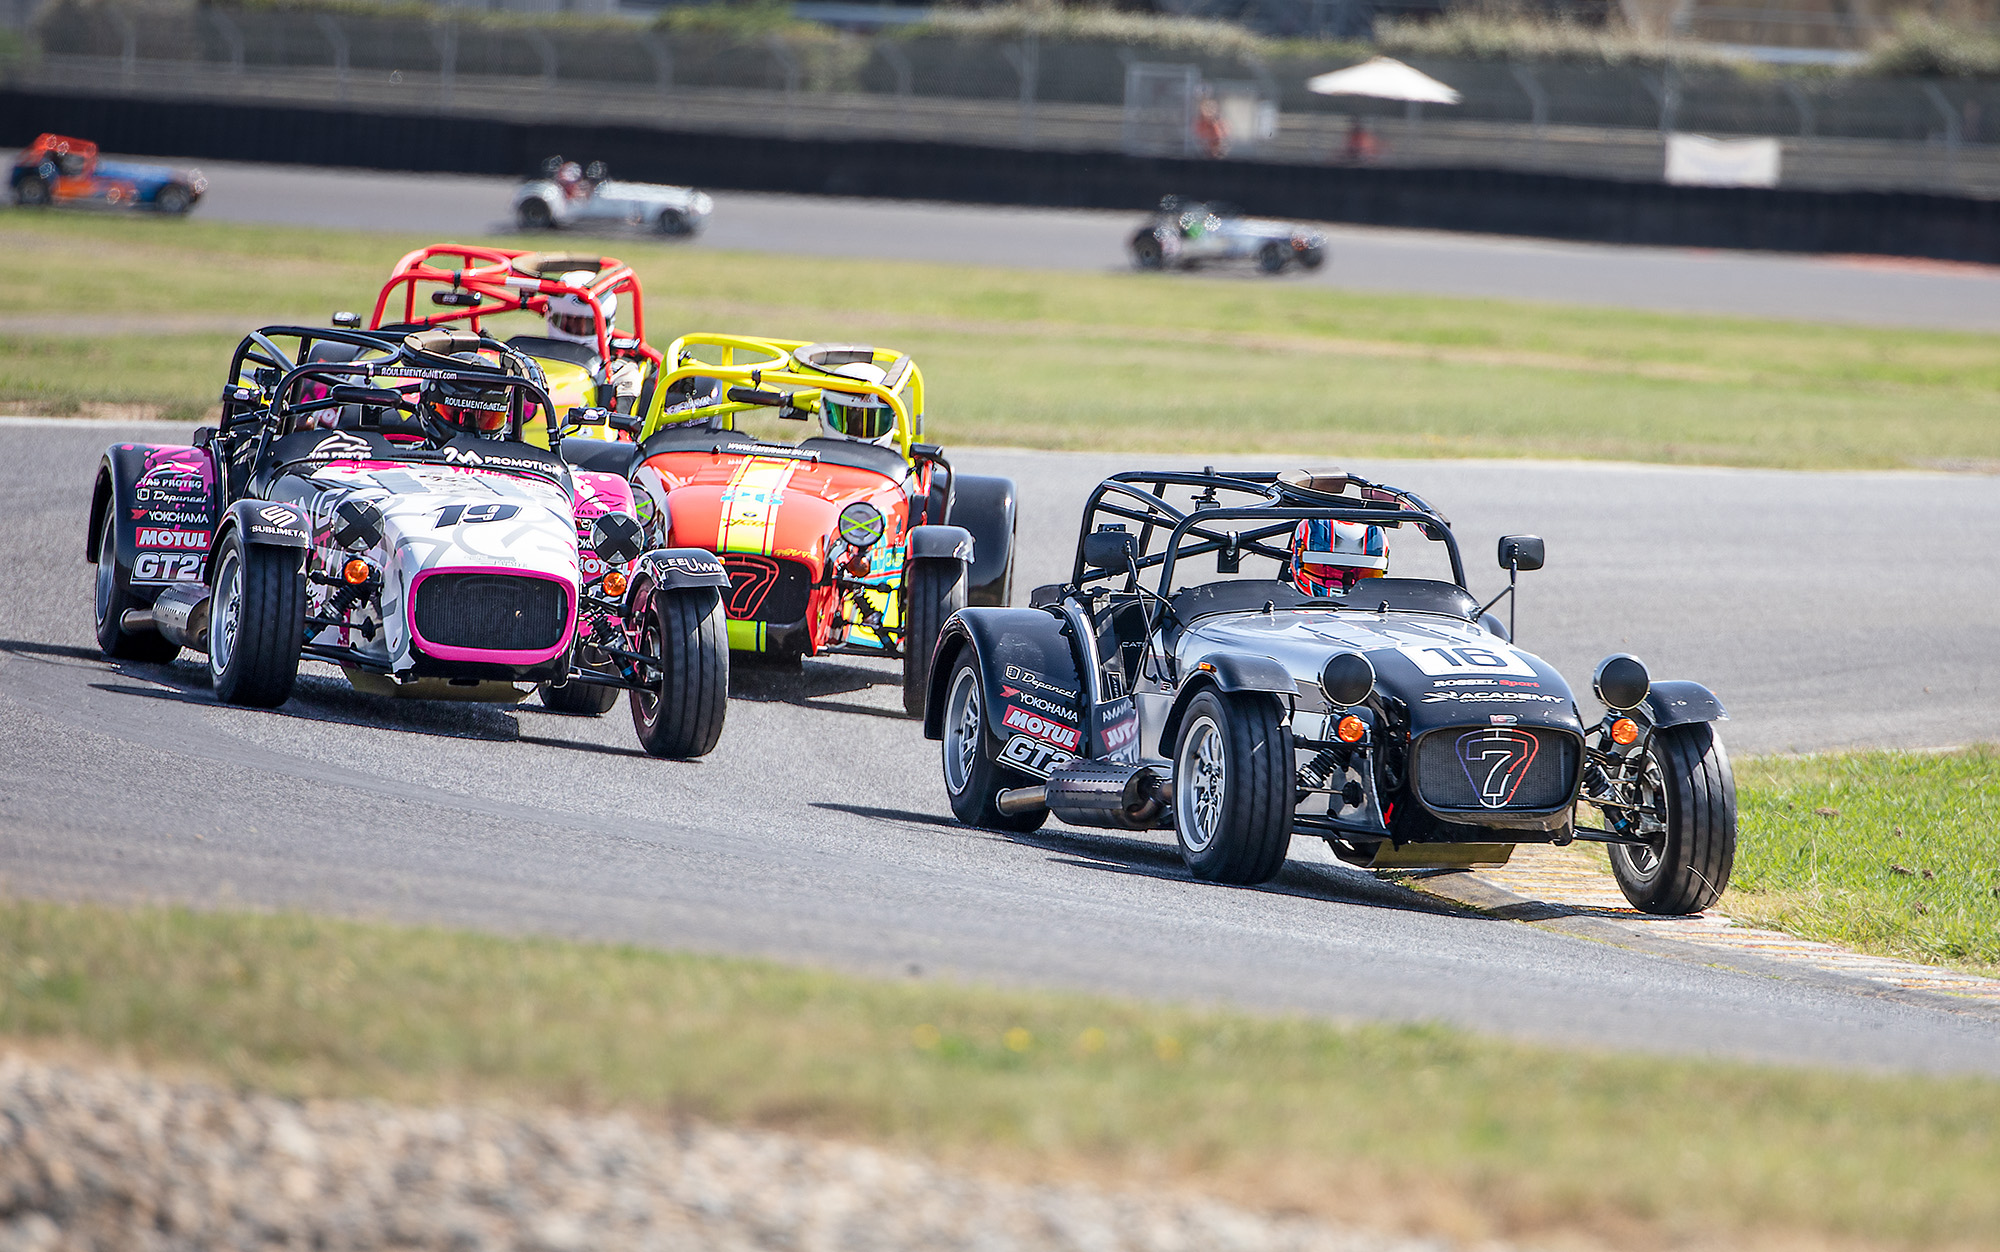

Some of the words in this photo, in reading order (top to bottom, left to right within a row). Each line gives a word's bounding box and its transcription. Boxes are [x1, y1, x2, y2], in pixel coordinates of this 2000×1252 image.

[484, 456, 561, 476] PROMOTION
[148, 511, 209, 523] YOKOHAMA
[430, 503, 523, 530] 19
[139, 530, 208, 547] MOTUL
[1421, 647, 1508, 667] 16
[1021, 671, 1078, 699] Depancel
[1499, 679, 1540, 688] Sport
[1020, 692, 1079, 723] YOKOHAMA
[1459, 692, 1565, 703] ACADEMY
[1006, 710, 1076, 748] MOTUL
